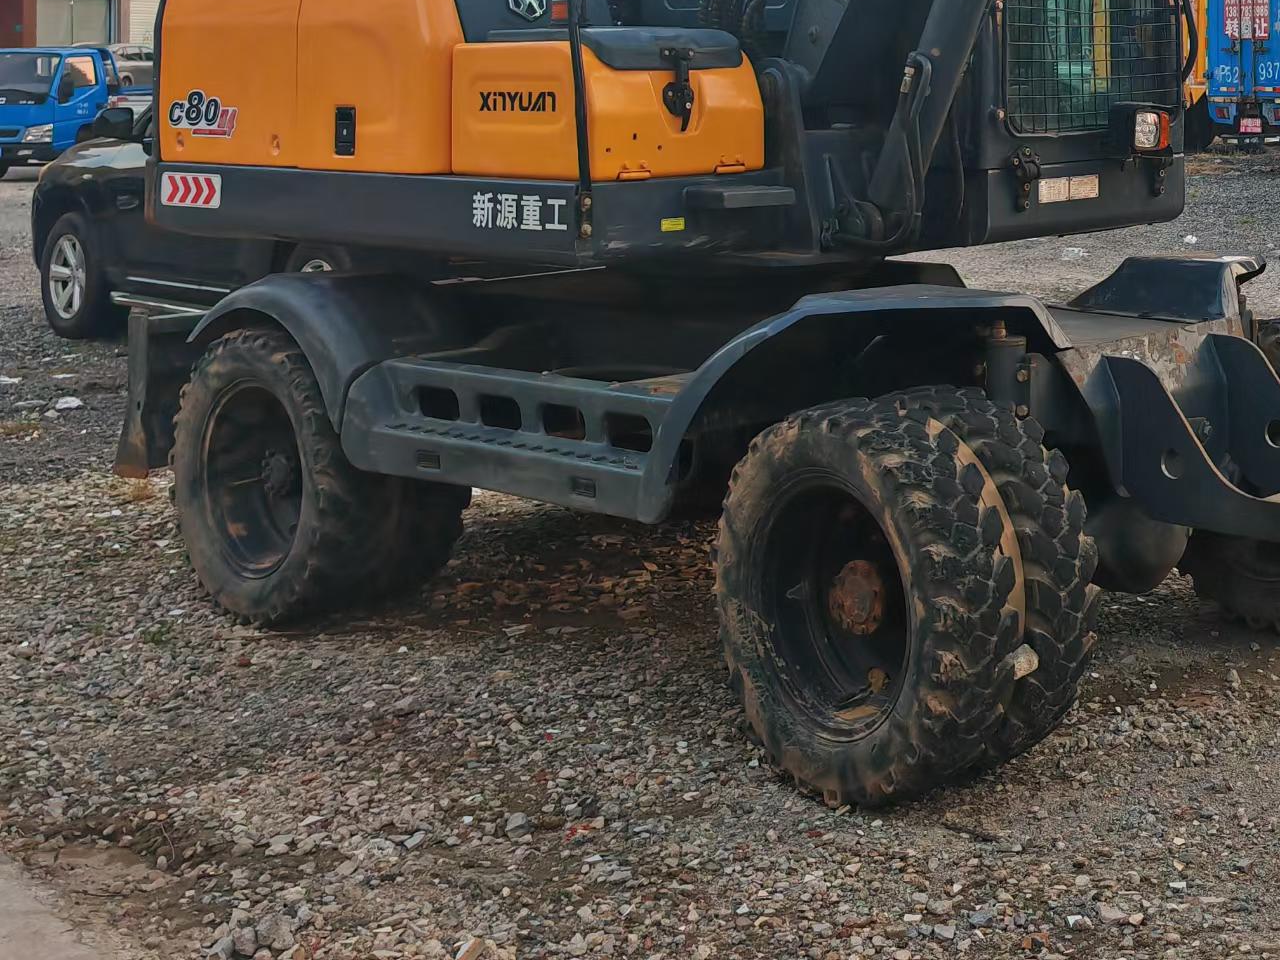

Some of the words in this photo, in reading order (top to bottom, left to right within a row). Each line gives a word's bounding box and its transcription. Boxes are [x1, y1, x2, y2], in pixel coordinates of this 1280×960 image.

[1258, 61, 1280, 81] 937
[472, 191, 568, 231] 新源重工
